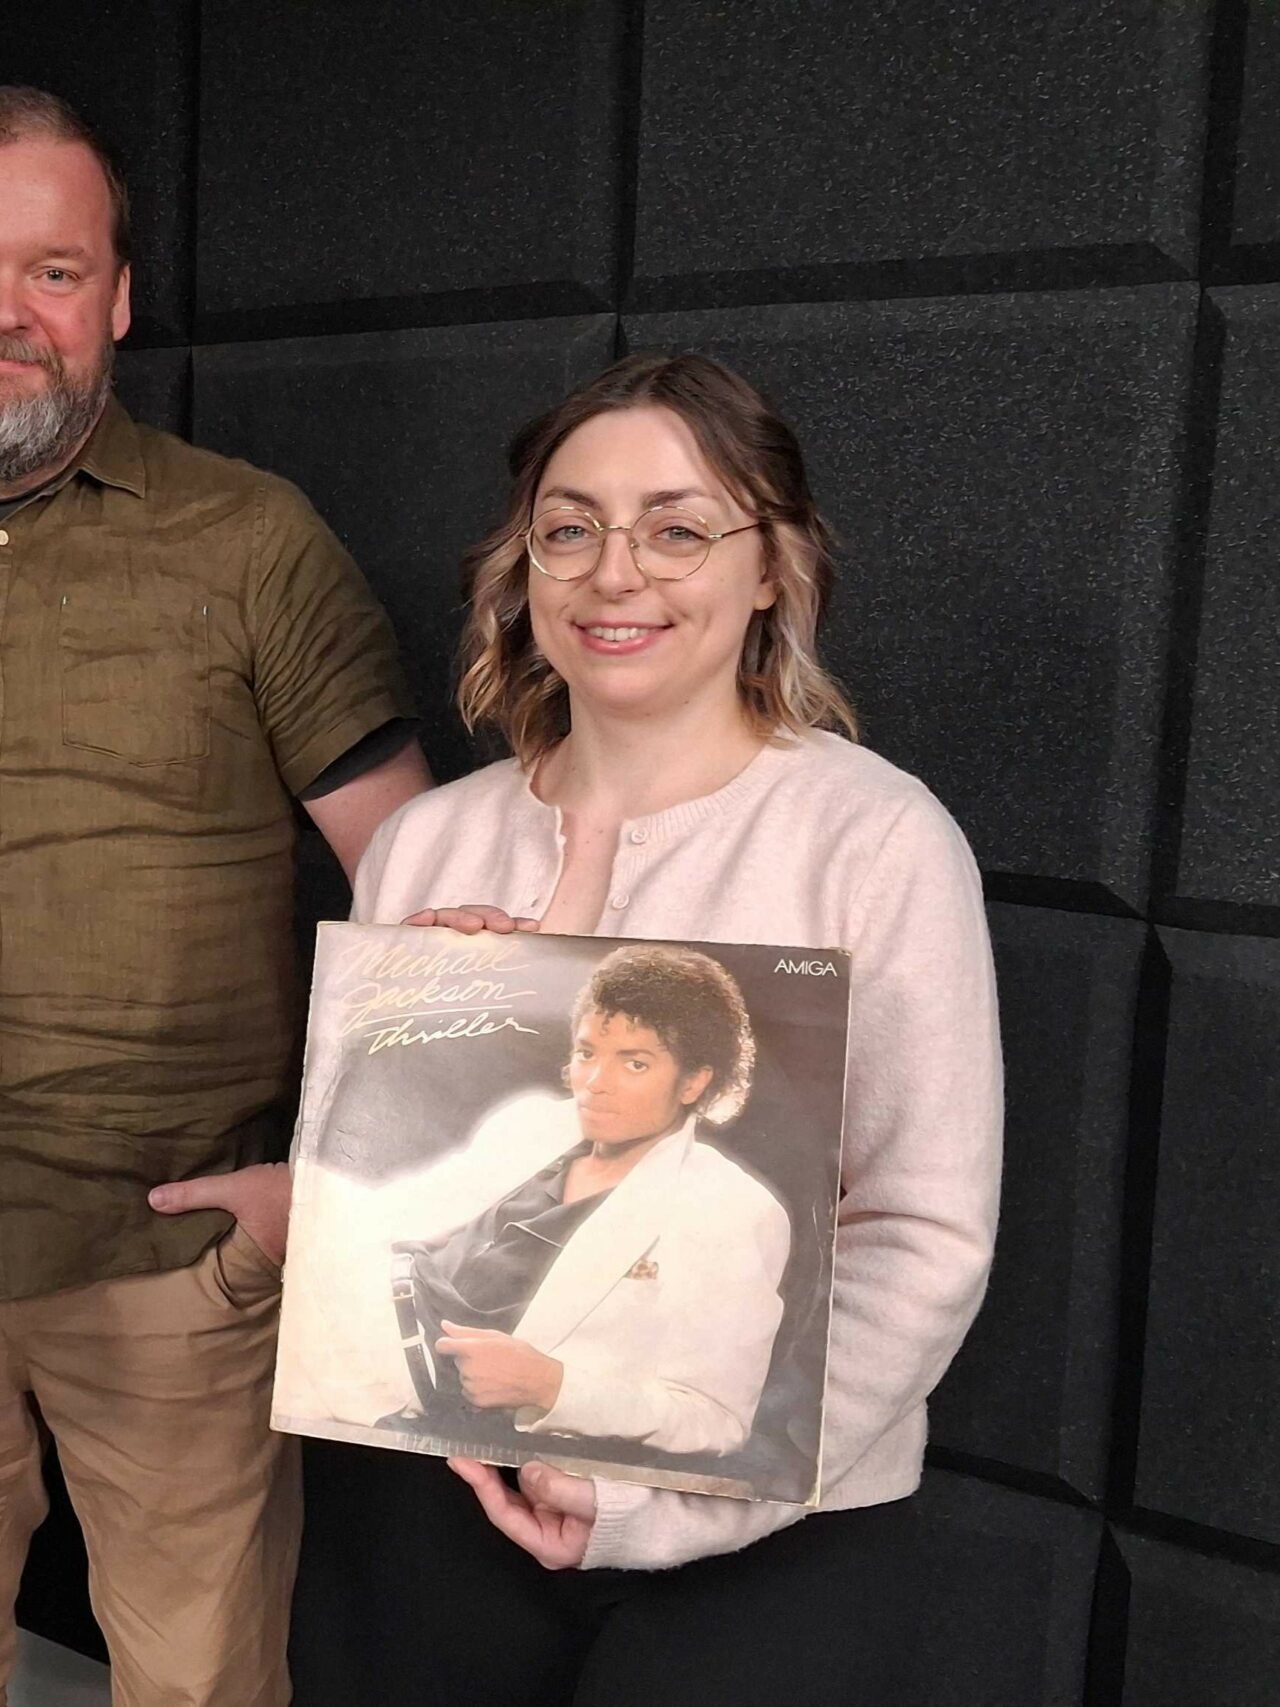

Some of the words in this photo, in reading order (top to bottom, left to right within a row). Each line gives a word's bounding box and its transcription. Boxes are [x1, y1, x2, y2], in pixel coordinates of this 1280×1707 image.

[337, 941, 530, 983] Michael
[774, 958, 838, 977] AMIGA
[340, 976, 537, 1037] Jackson
[363, 1012, 540, 1055] Thriller
